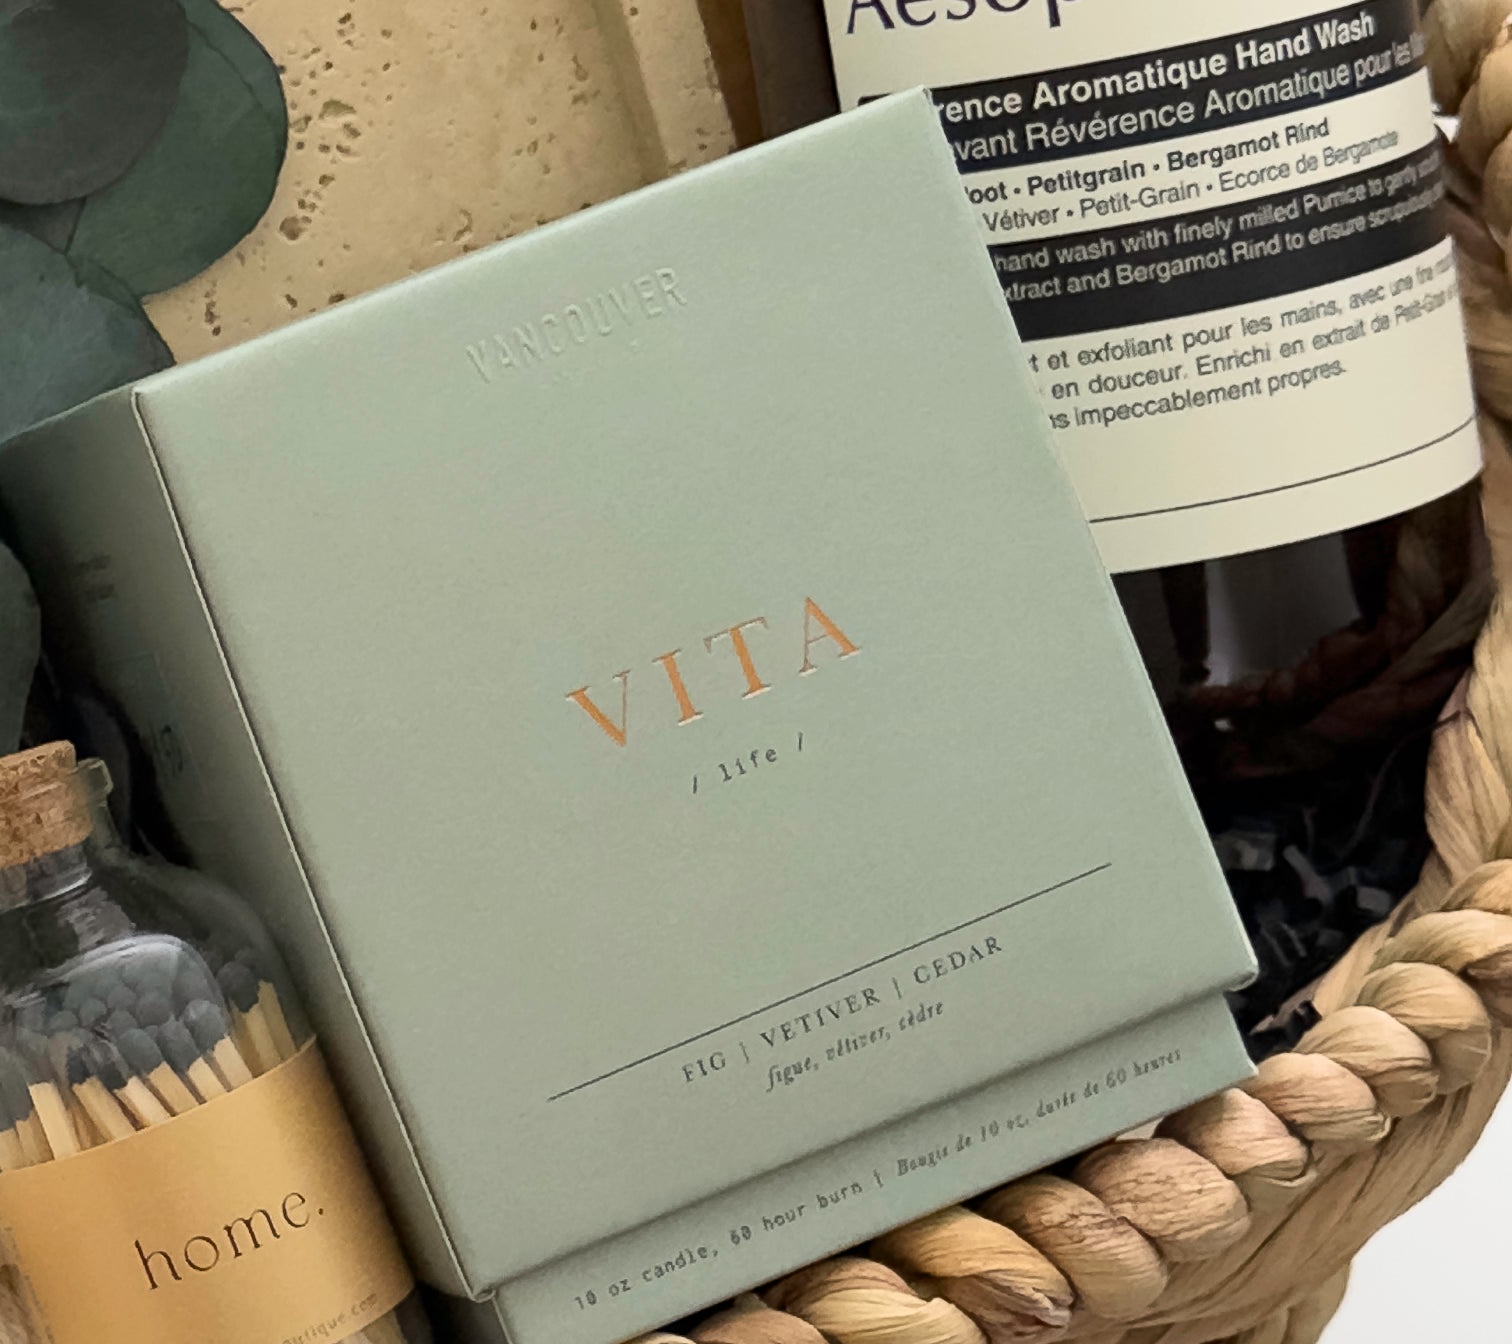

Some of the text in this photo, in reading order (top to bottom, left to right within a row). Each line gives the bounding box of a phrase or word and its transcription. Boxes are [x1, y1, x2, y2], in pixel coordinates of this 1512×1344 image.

[937, 92, 1023, 123] ence
[1032, 53, 1227, 110] Aromatique
[1236, 27, 1310, 71] Hand
[1315, 10, 1376, 49] Wash
[952, 128, 1018, 161] vant
[1025, 100, 1195, 152] Révérence
[1204, 62, 1350, 119] Aromatique
[964, 117, 1330, 204] oot Petitgrain Bergamot Rind
[982, 205, 1060, 232] Vétiver
[1079, 180, 1201, 218] Petit-Grain
[1219, 157, 1291, 193] Ecorce
[1295, 151, 1319, 174] de
[993, 247, 1050, 272] hand
[1056, 237, 1116, 264] wash
[1121, 229, 1169, 252] with
[1174, 215, 1233, 244] finely
[1067, 267, 1111, 294] and
[1115, 250, 1228, 286] Bergamot
[1231, 232, 1282, 264] Rind
[1285, 227, 1305, 250] to
[1308, 215, 1366, 246] ensure
[465, 267, 688, 384] VANCOUVER
[1047, 350, 1070, 371] et
[1077, 332, 1174, 366] exfoliant
[1182, 323, 1233, 353] pour
[1240, 316, 1273, 337] les
[1051, 378, 1080, 400] en
[1196, 342, 1272, 376] Enrichi
[1279, 339, 1305, 358] en
[1074, 377, 1262, 427] impeccablement
[565, 596, 862, 747] VITA
[717, 748, 778, 783] life
[680, 1050, 728, 1084] FIG
[758, 986, 882, 1049] VETIVER
[913, 937, 1004, 986] CEDAR
[134, 1192, 324, 1290] home.
[574, 1290, 598, 1311] 10
[608, 1278, 632, 1298] oz
[642, 1245, 720, 1284] candle,
[762, 1204, 807, 1233] hour
[816, 1181, 863, 1210] burn
